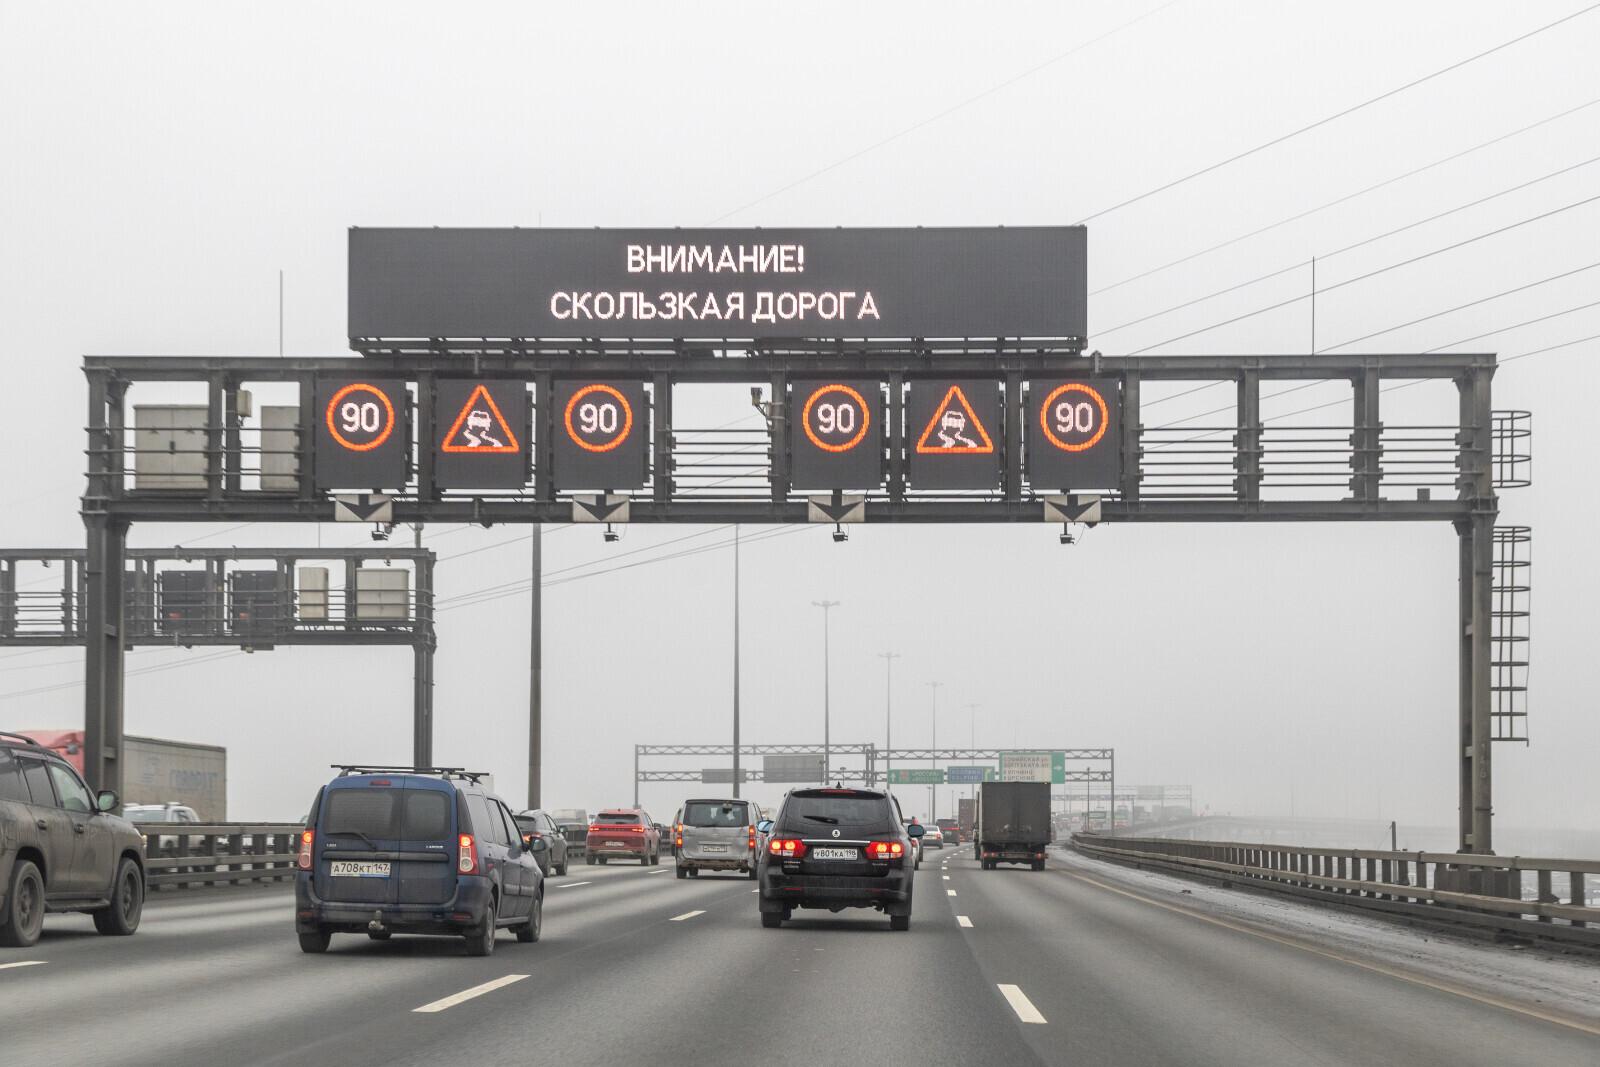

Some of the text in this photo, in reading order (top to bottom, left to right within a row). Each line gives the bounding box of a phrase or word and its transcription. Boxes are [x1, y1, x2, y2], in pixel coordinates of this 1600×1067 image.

[626, 244, 805, 274] ВНИМАНИЕ!
[550, 290, 881, 325] СКОЛЬЗКАЯ ДОРОГА
[341, 402, 380, 433] 90
[579, 402, 618, 434] 90
[817, 402, 855, 434] 90
[1055, 402, 1094, 433] 90
